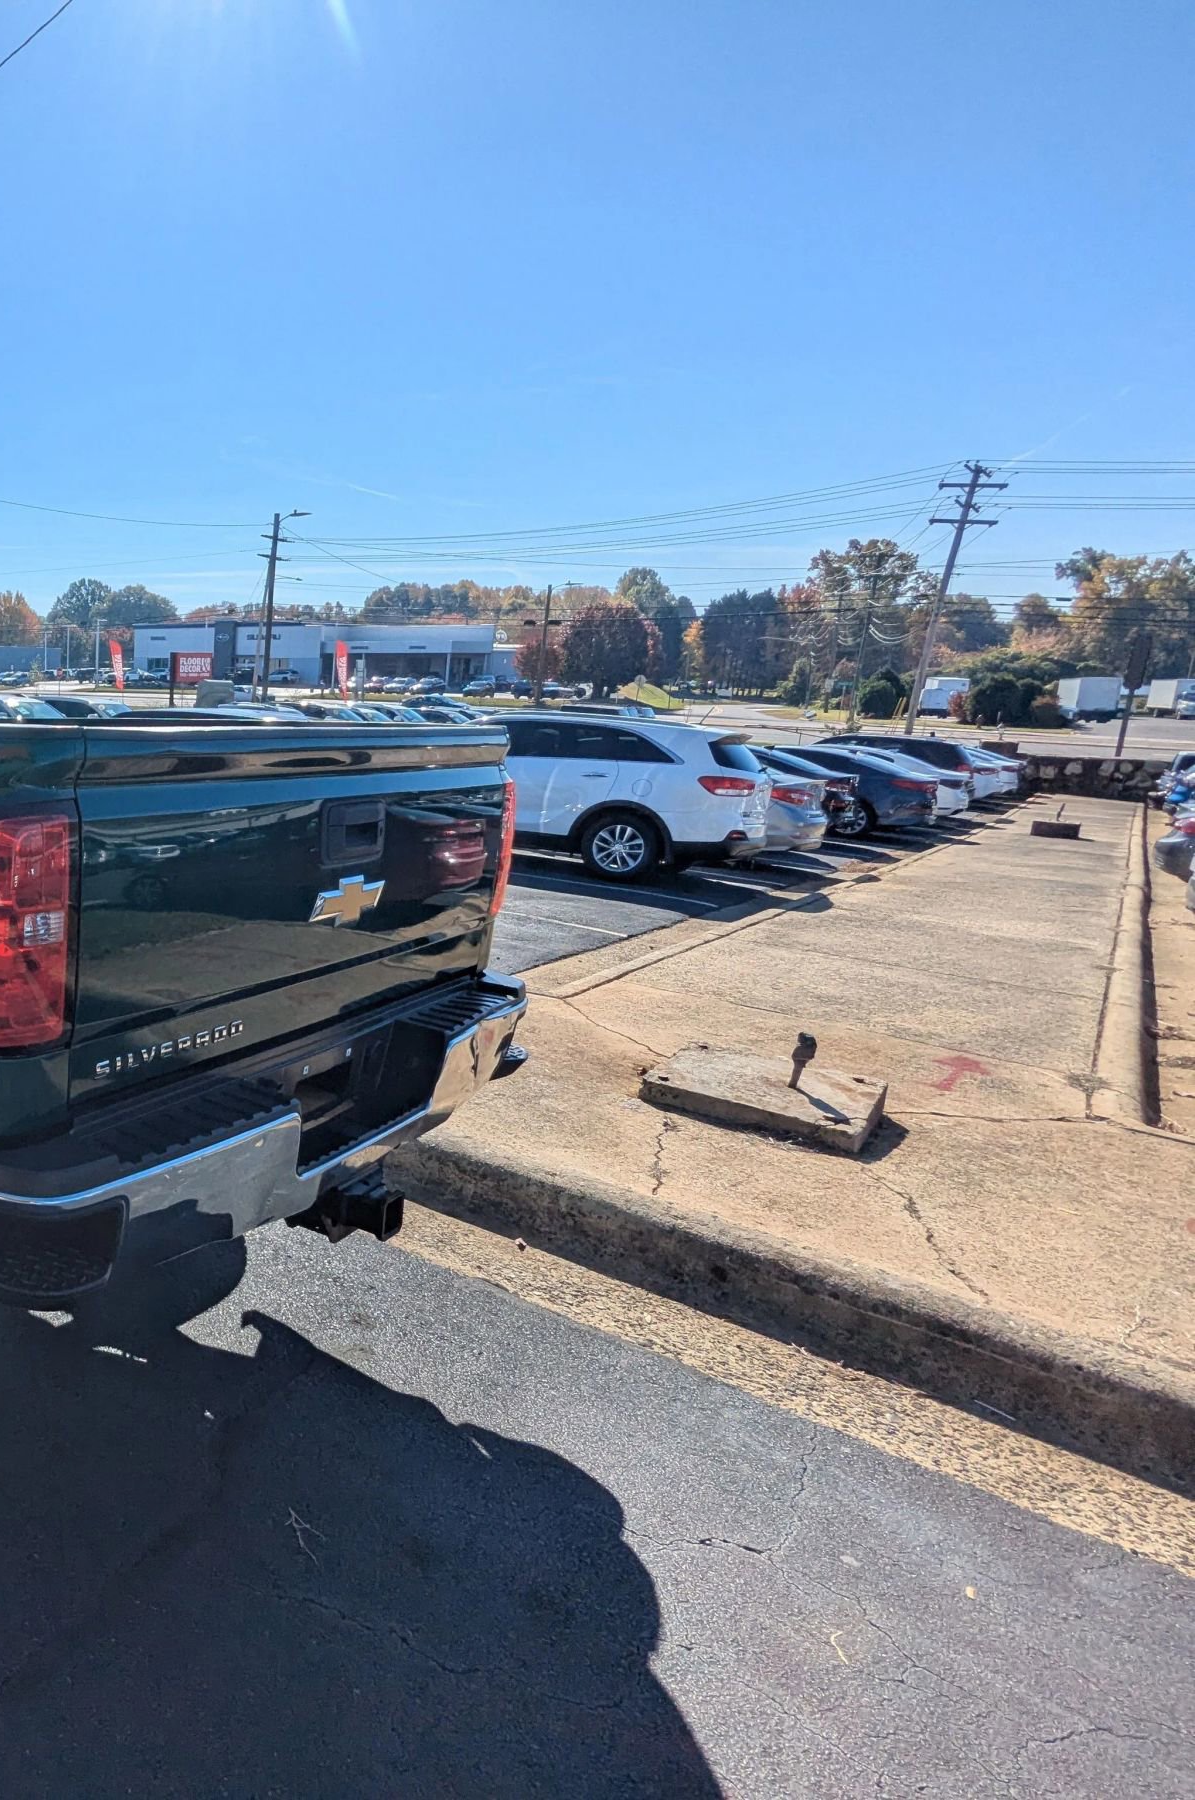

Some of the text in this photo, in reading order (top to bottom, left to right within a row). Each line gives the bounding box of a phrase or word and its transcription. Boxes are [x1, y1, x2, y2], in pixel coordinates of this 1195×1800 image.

[246, 633, 281, 641] SURU
[179, 657, 202, 665] FLOOR
[179, 664, 201, 673] DECOR
[94, 1019, 244, 1080] SILVERADO
